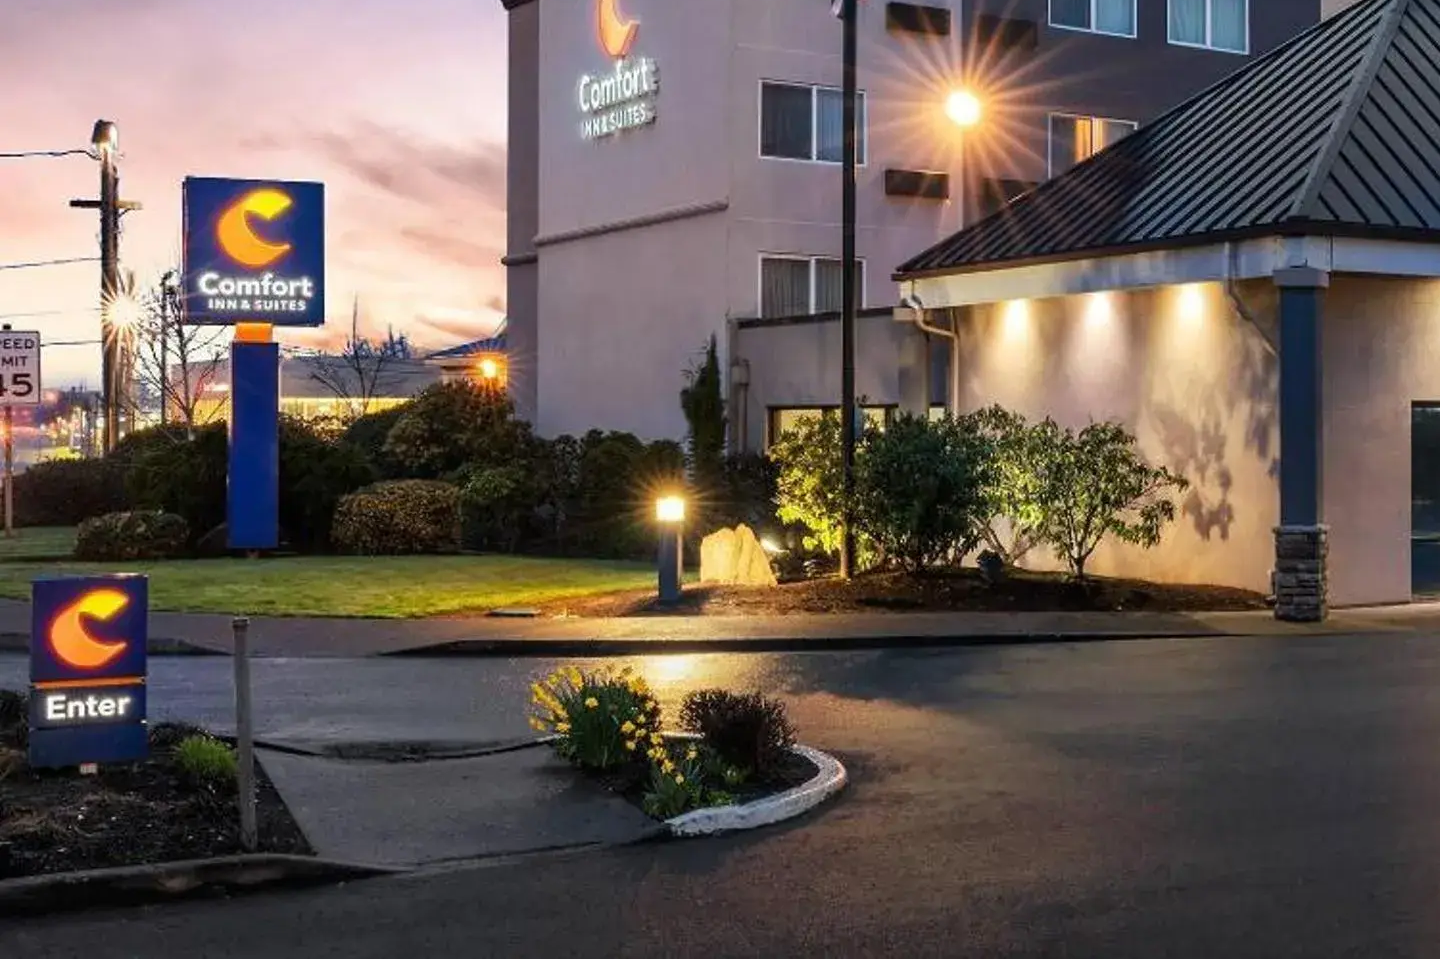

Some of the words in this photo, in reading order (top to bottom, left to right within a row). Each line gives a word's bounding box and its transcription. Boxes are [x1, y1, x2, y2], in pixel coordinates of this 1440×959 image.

[579, 57, 648, 113] Comfort
[609, 103, 646, 130] SUITES
[198, 271, 313, 298] Comfort
[207, 298, 227, 310] INN
[231, 299, 250, 310] &
[253, 299, 306, 312] SUITES
[0, 338, 34, 349] EED
[0, 356, 28, 367] MIT
[46, 696, 131, 720] Enter
